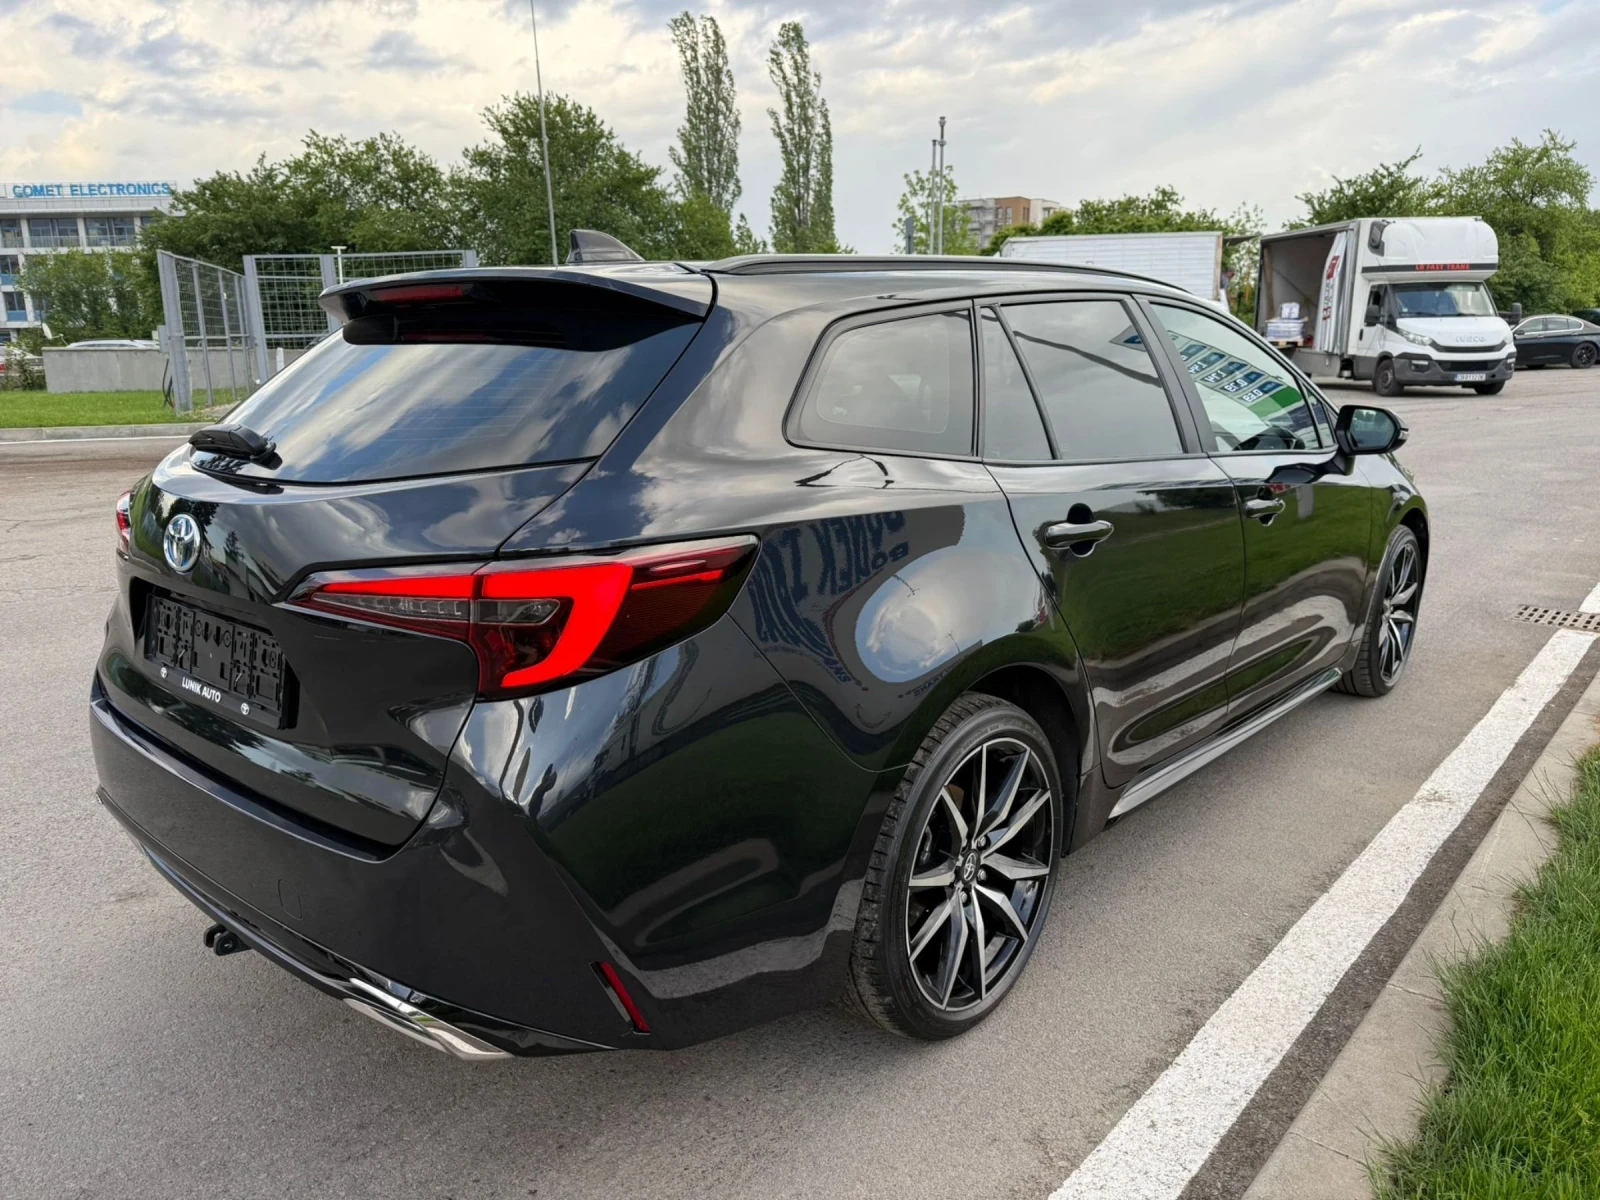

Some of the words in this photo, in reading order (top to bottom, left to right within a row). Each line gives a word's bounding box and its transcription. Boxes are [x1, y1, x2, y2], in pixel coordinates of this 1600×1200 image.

[12, 184, 62, 198] COMET
[70, 182, 171, 197] ELECTRONICS
[1455, 335, 1486, 343] IVECO
[181, 676, 202, 695] LUNIK
[201, 686, 221, 703] AUTO
